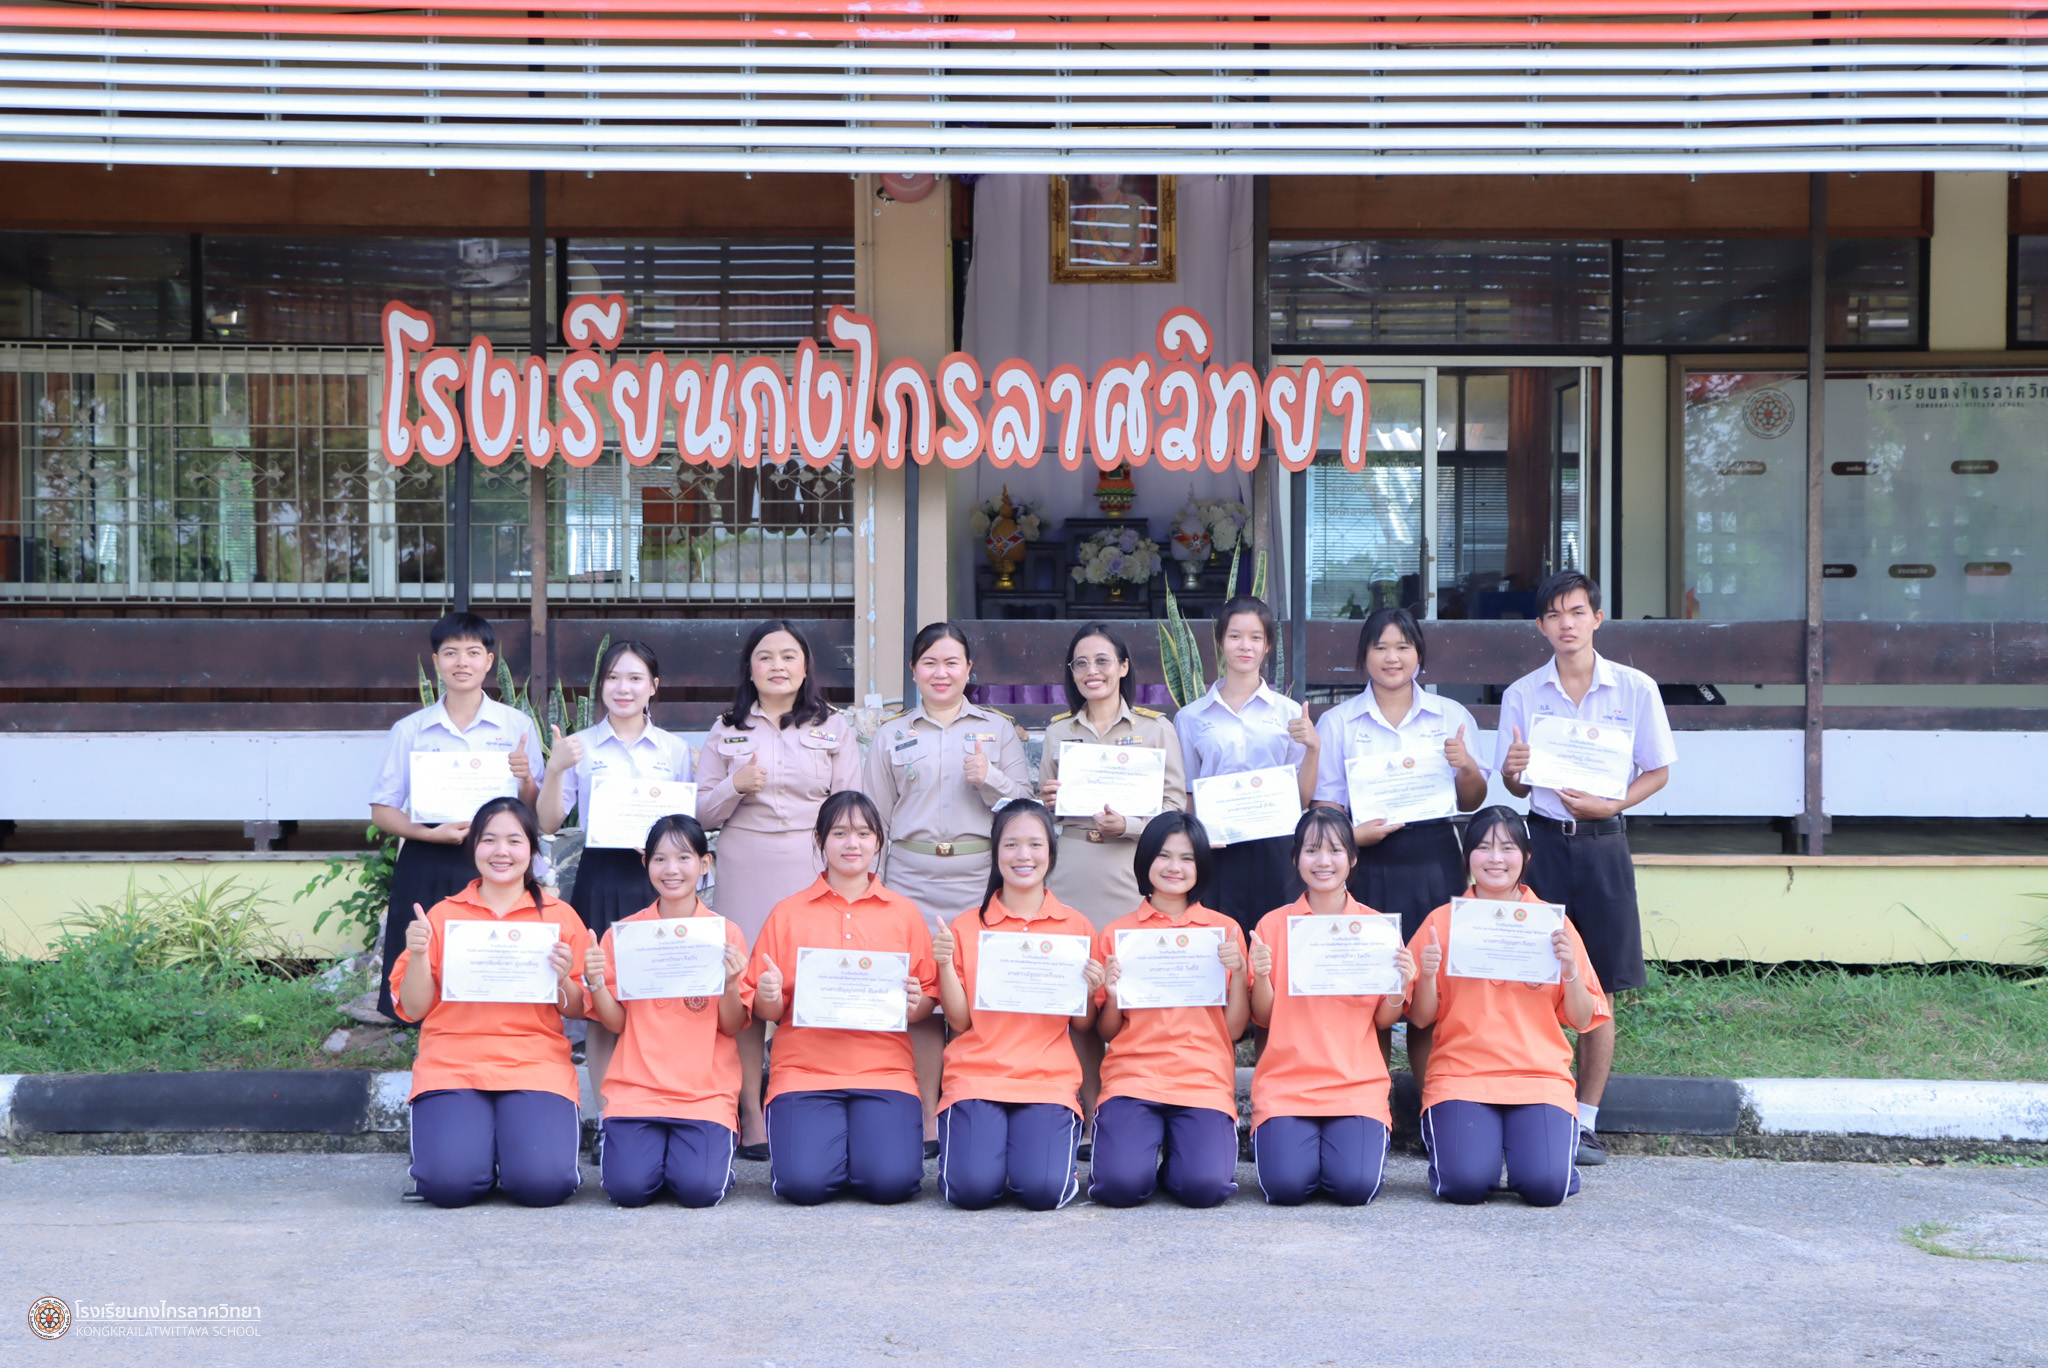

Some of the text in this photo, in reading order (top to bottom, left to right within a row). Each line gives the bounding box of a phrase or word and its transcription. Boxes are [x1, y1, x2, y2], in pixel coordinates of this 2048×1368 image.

[383, 295, 1369, 471] โรงเรียนกงไกรลาศวิทยา
